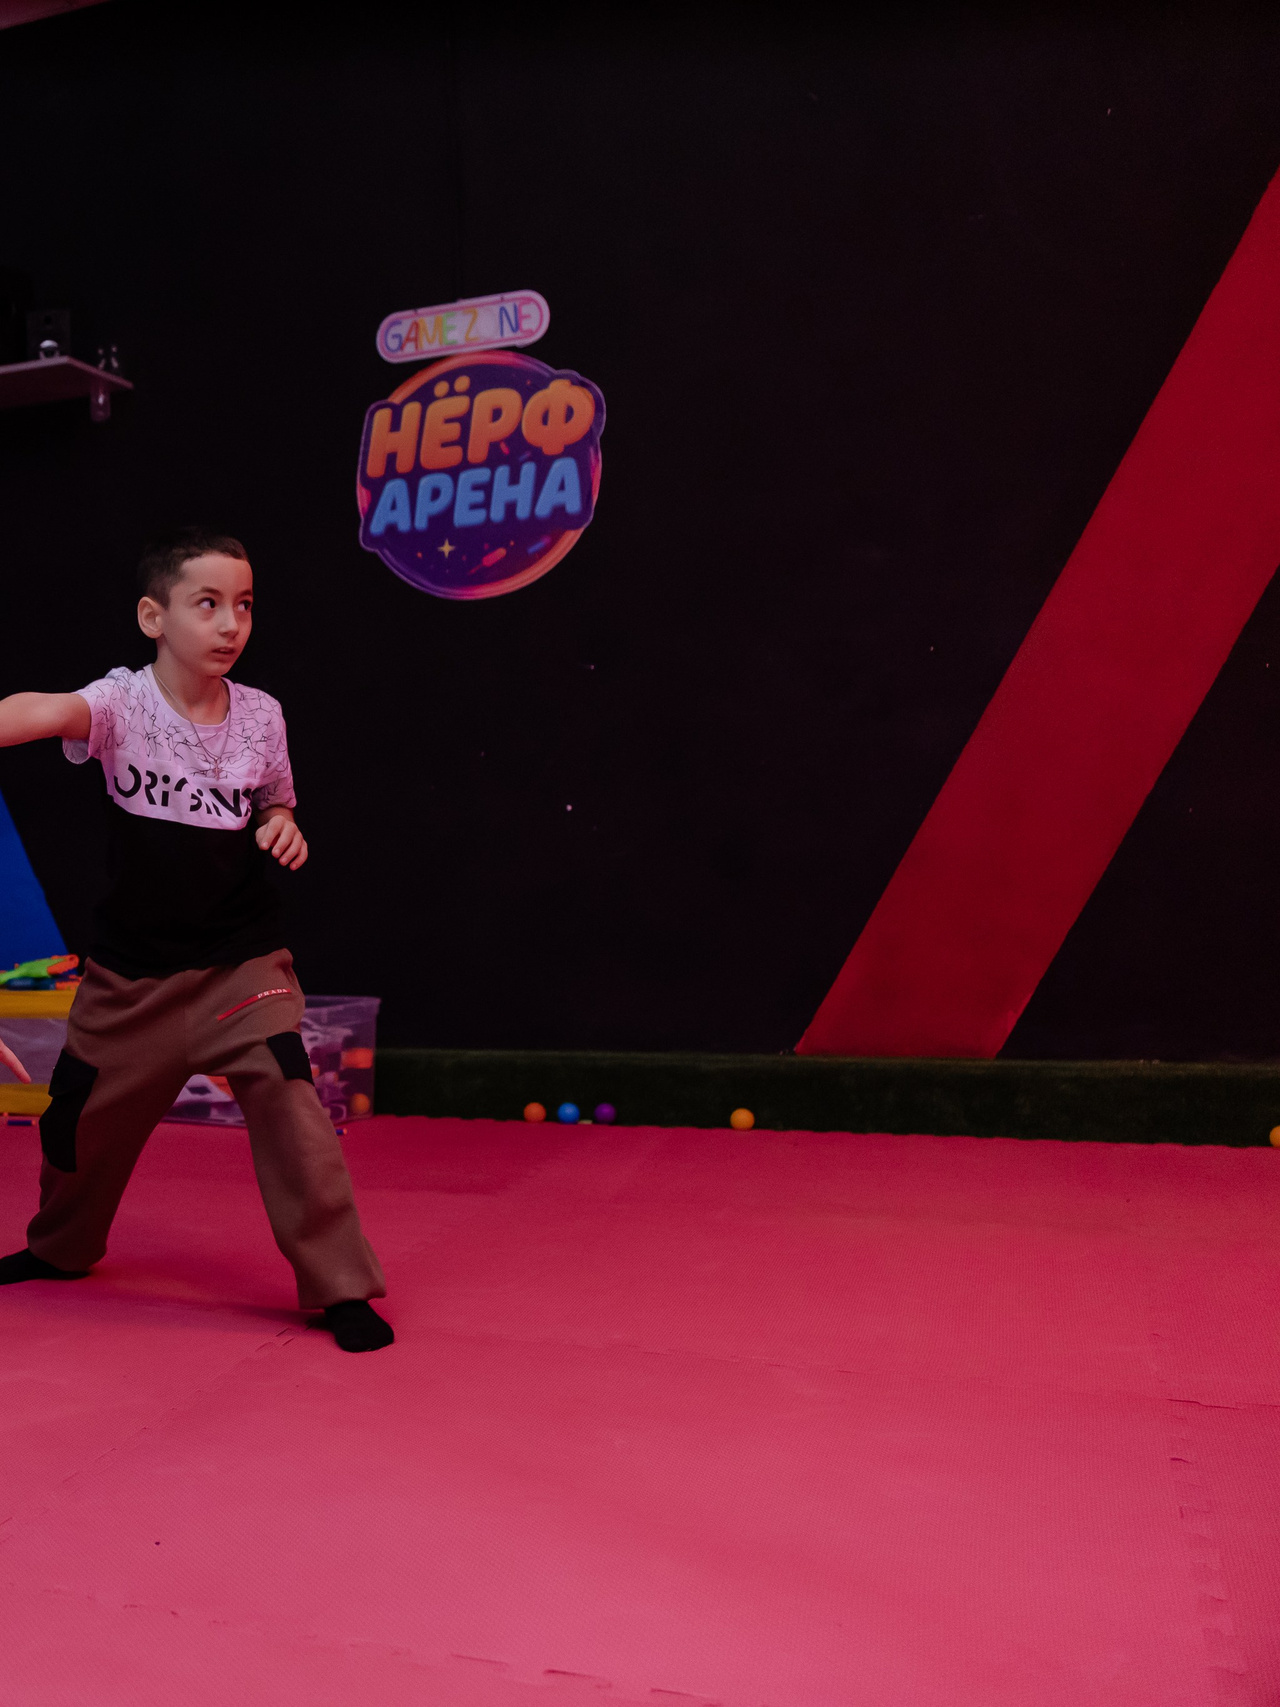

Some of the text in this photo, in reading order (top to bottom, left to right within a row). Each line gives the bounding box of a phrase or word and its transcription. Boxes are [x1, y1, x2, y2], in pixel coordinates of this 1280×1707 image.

[384, 301, 536, 352] GAME ZNE
[366, 375, 595, 478] НЁРФ
[370, 457, 582, 536] АРЕНА
[257, 988, 288, 999] PRADA
